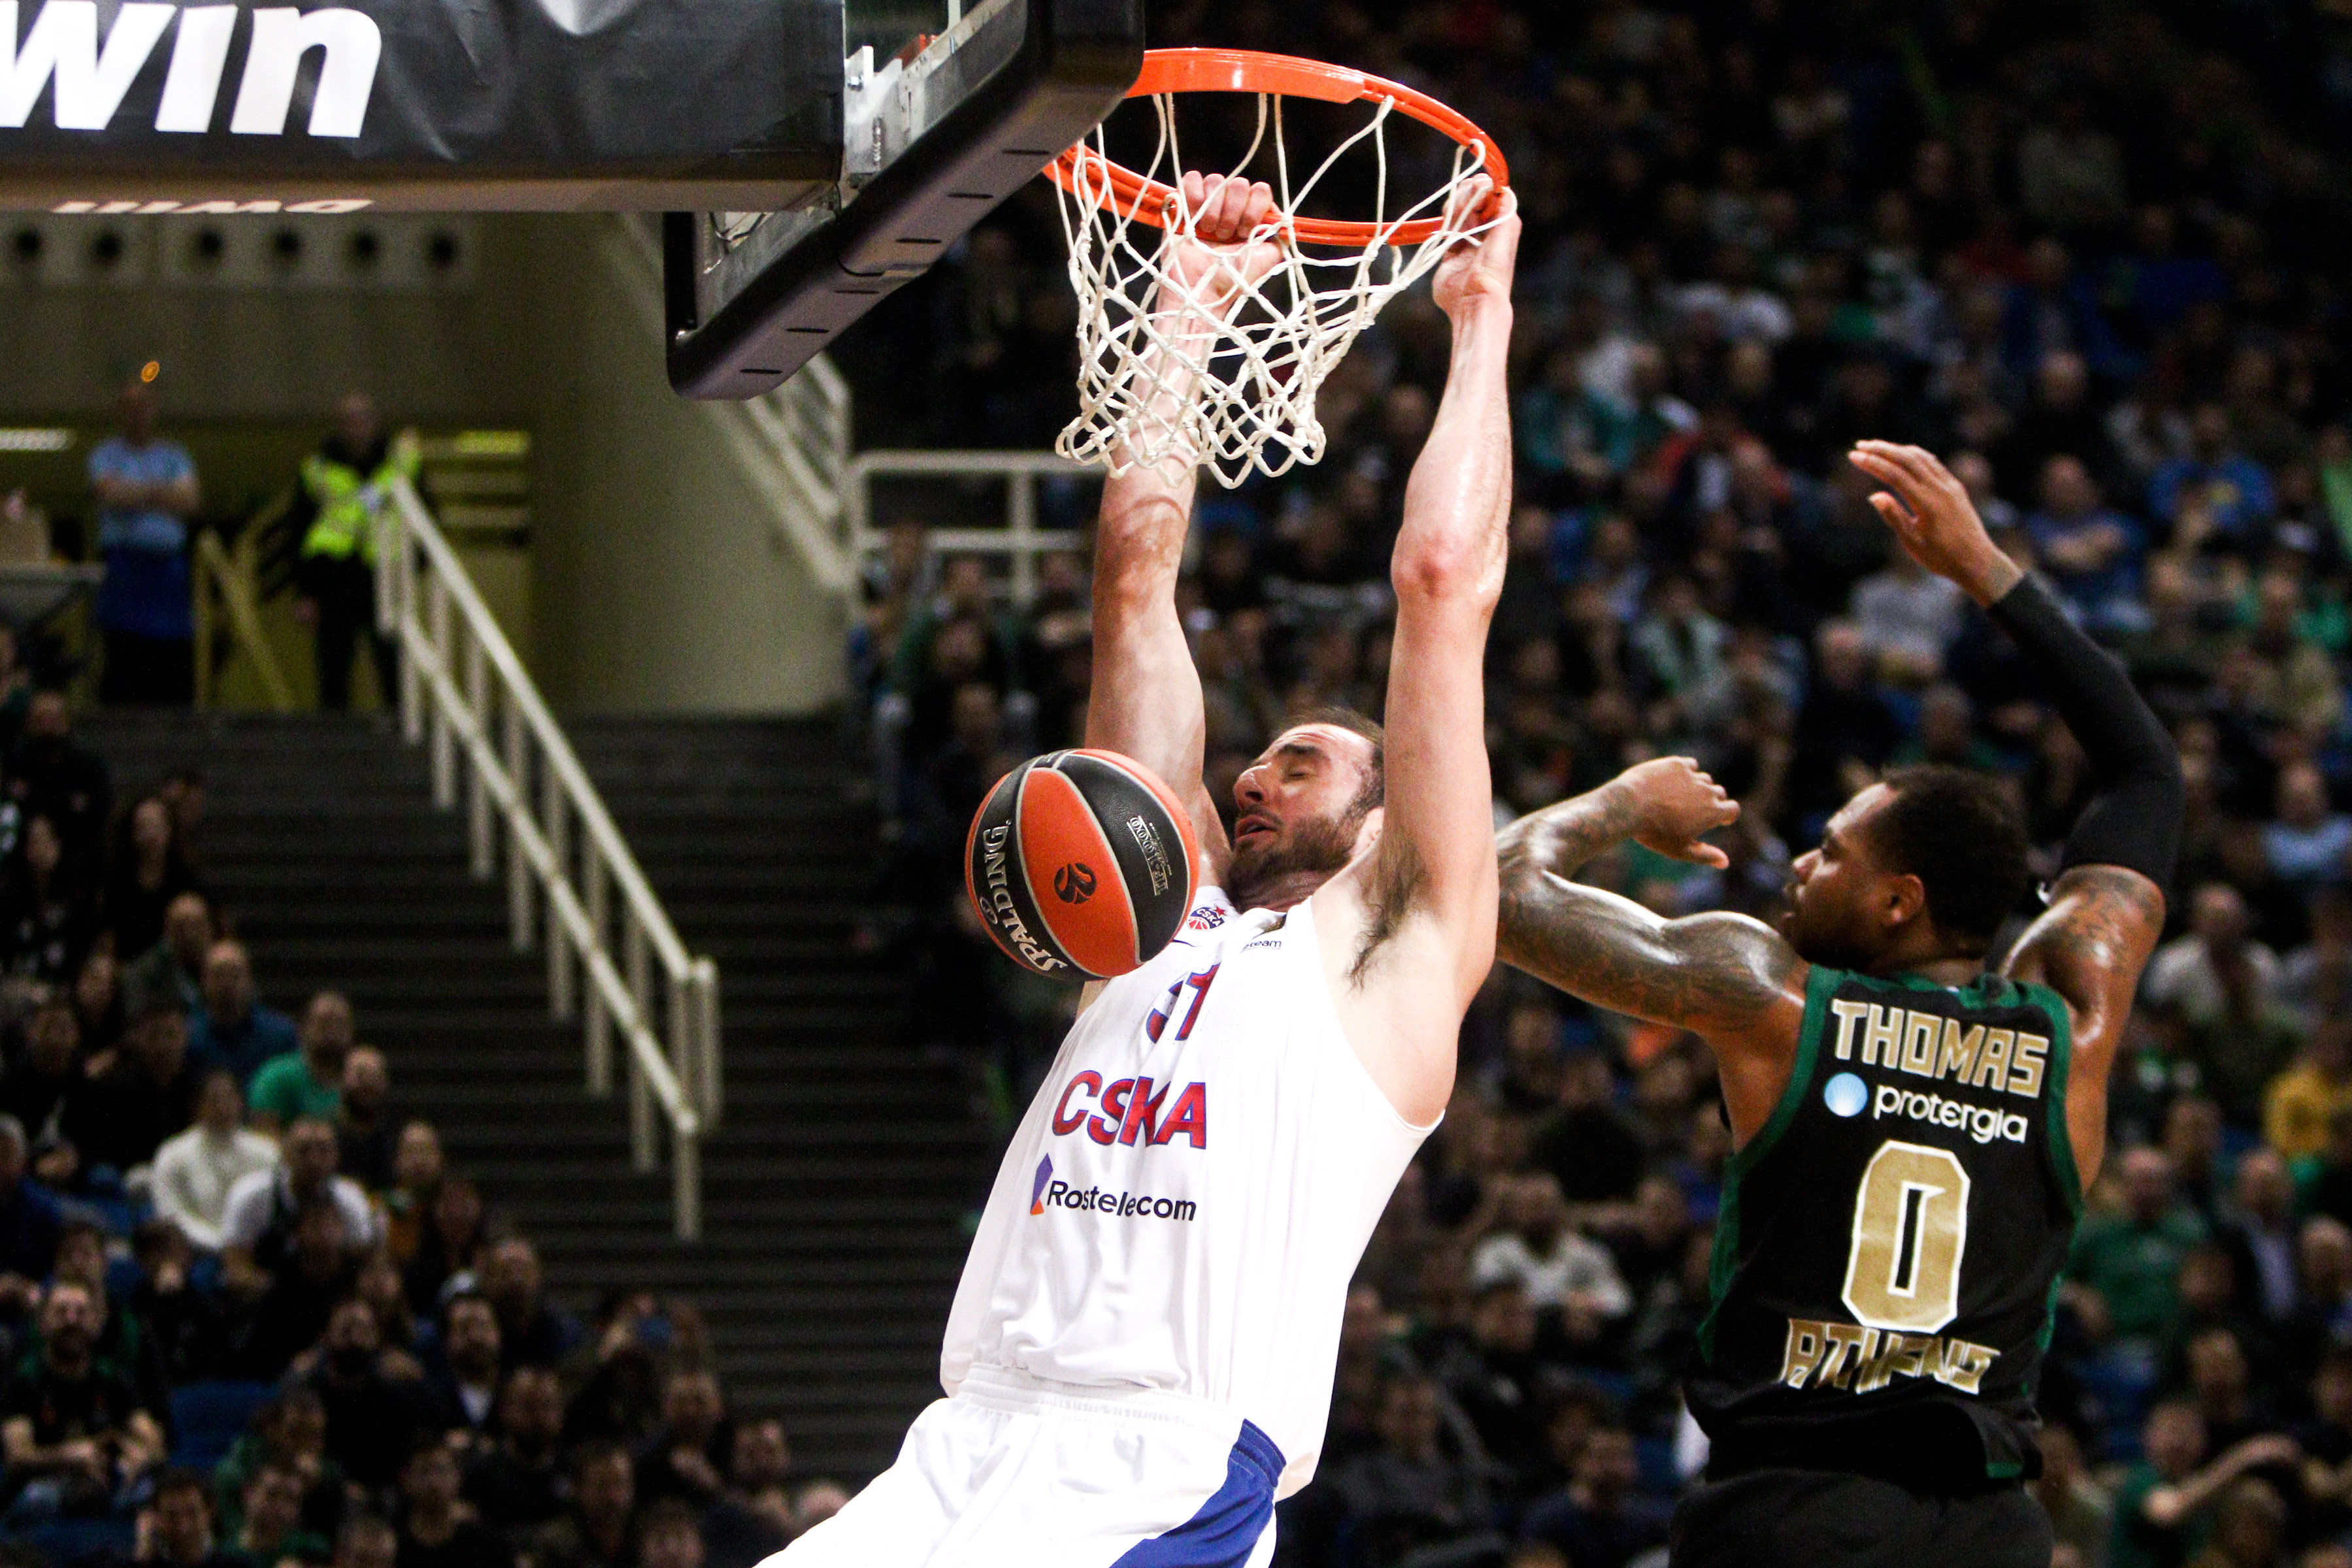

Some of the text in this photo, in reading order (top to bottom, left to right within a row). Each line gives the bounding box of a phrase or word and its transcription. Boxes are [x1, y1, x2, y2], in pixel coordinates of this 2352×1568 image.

[983, 825, 1068, 972] SPALDING
[1196, 908, 1221, 926] CSKA
[1830, 998, 2050, 1098] THOMAS
[1052, 1070, 1207, 1150] CSKA
[1873, 1084, 2029, 1145] protergia
[1046, 1180, 1197, 1221] Rostelecom
[1841, 1139, 1971, 1334] 0
